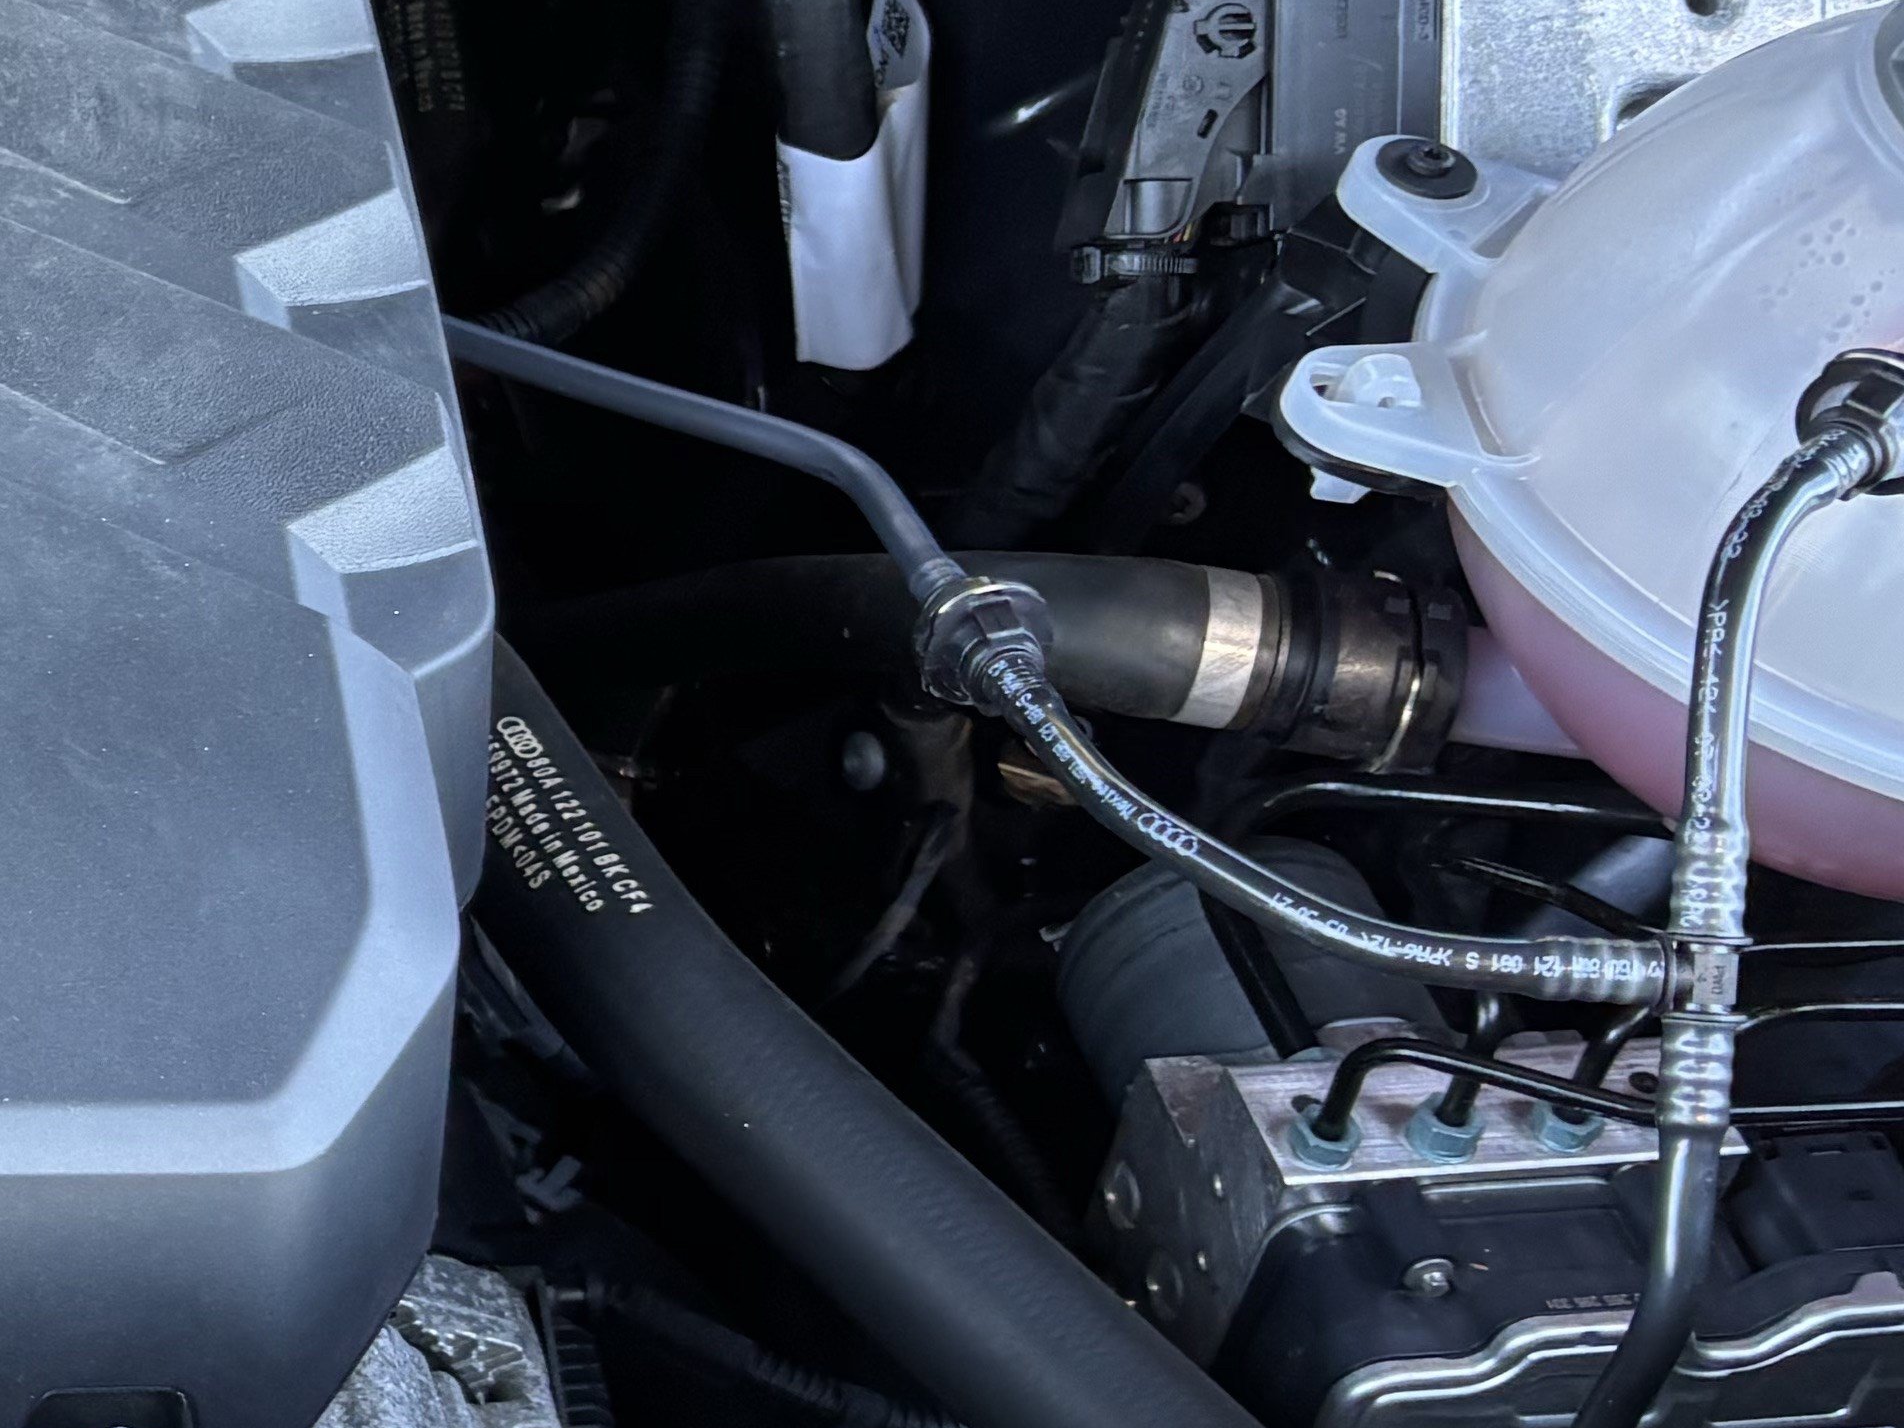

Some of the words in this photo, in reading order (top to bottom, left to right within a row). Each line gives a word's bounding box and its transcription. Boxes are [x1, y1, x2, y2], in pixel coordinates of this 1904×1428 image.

[510, 788, 550, 835] Made
[539, 831, 563, 853] in
[552, 849, 604, 912] Mexico
[526, 757, 564, 789] 80A
[550, 790, 587, 820] 122
[572, 821, 610, 852] 101
[593, 853, 630, 878] BK
